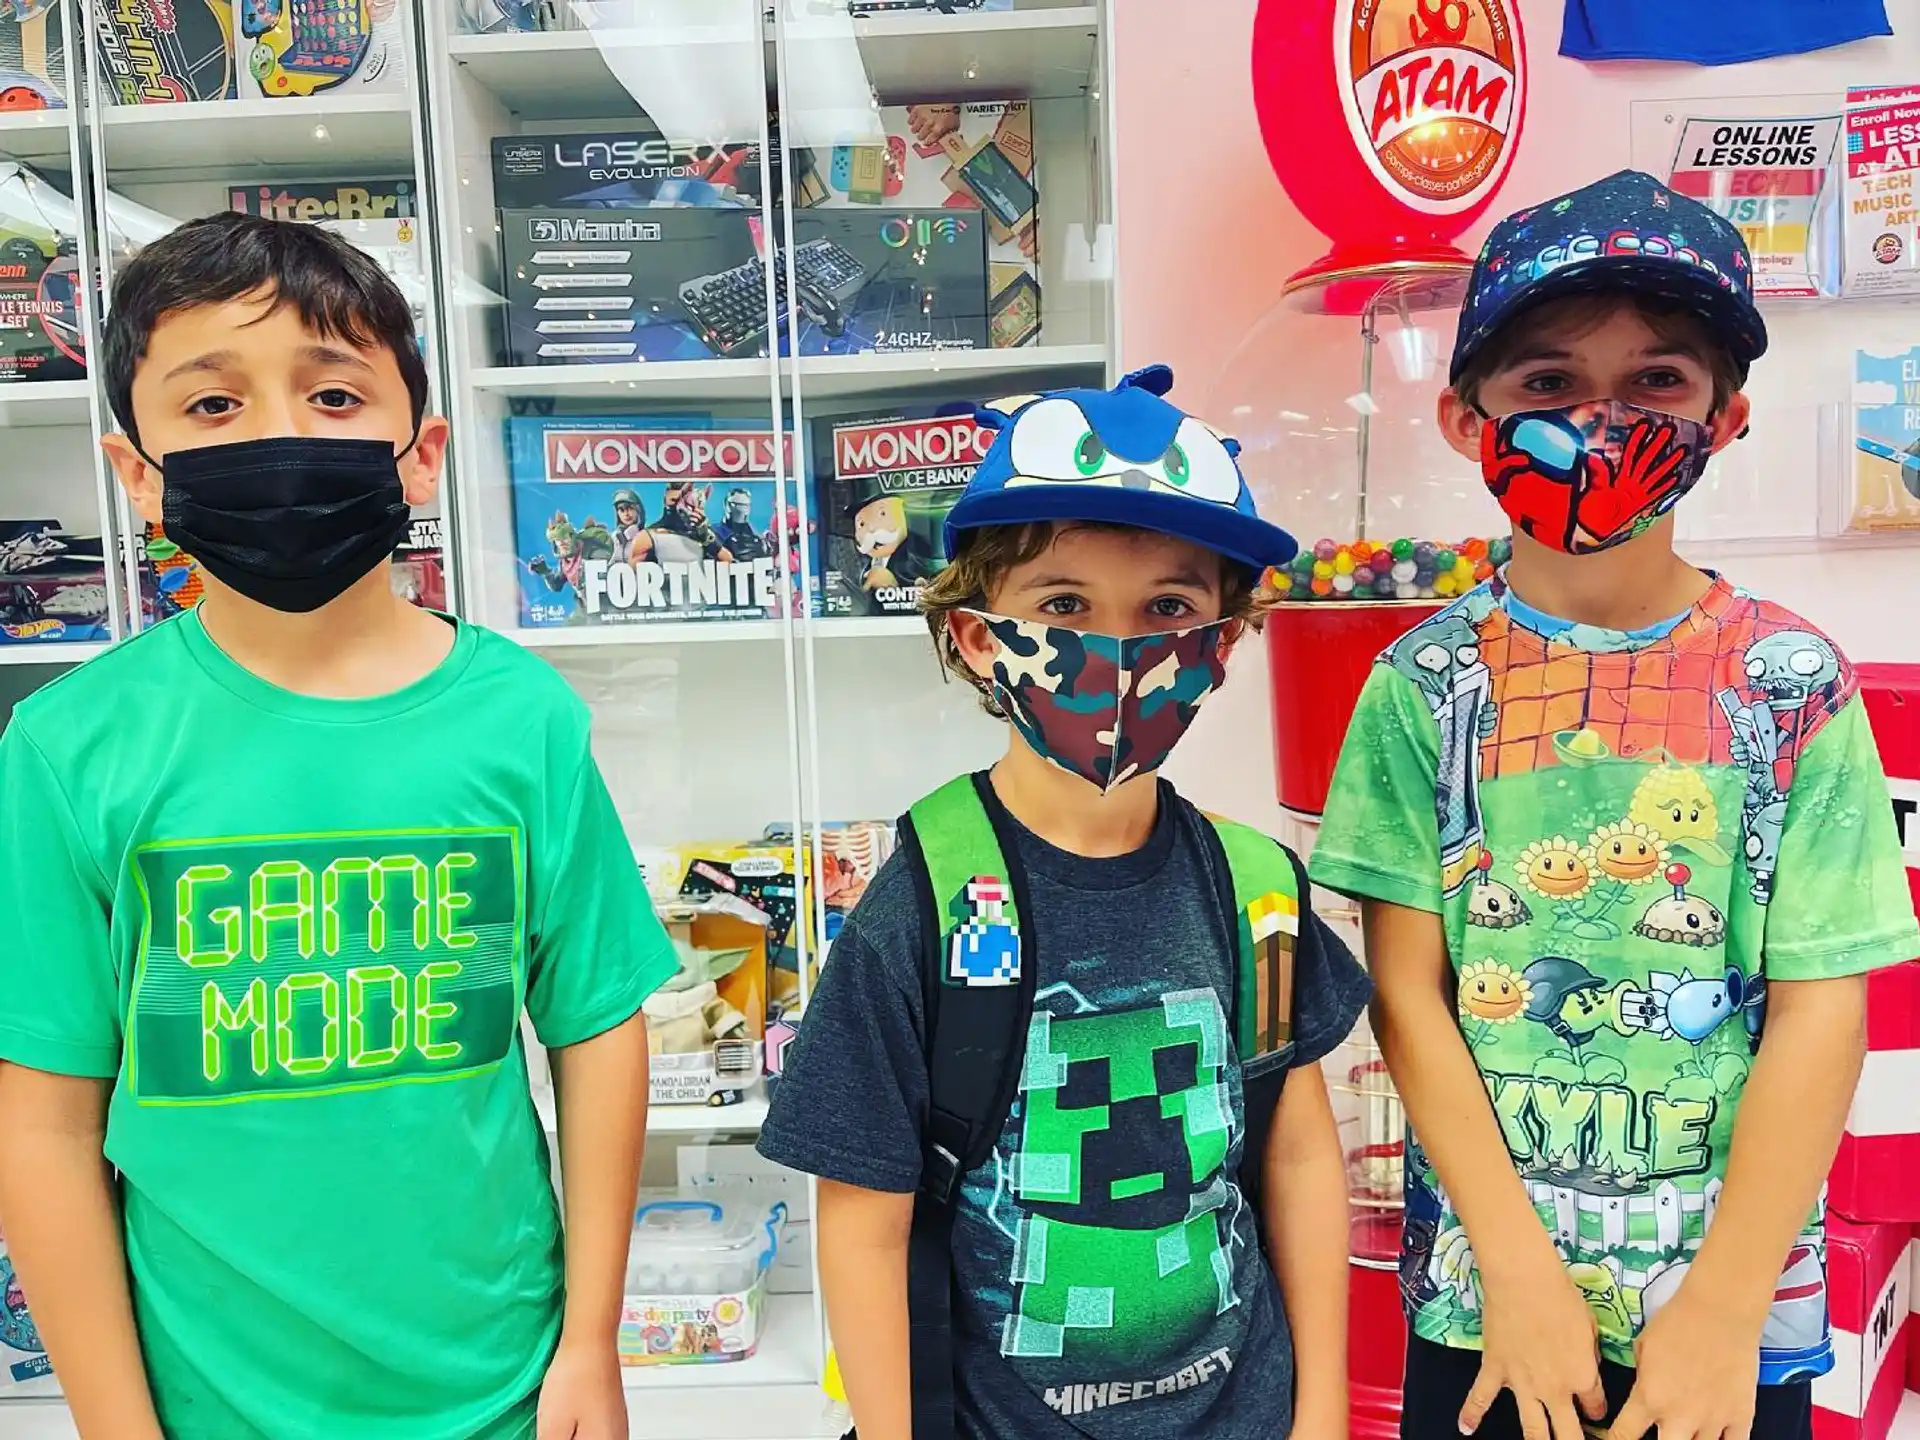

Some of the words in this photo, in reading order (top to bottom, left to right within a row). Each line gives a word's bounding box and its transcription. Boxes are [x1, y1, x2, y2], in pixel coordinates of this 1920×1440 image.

[966, 103, 1009, 114] VARIETY
[1371, 56, 1507, 142] ATAM
[1850, 110, 1890, 127] Enroll
[1712, 125, 1816, 146] ONLINE
[1692, 146, 1818, 167] LESSONS
[589, 165, 701, 180] EVOLUTION
[1862, 173, 1912, 194] TECH
[1854, 193, 1912, 215] MUSIC
[562, 218, 661, 241] Mamba
[19, 301, 64, 314] TENNIS
[874, 330, 933, 347] 2.4GHZ
[842, 424, 997, 470] MONOPO
[881, 470, 926, 489] VOICE
[585, 556, 776, 614] FORTNITE
[176, 851, 479, 968] GAME
[202, 960, 463, 1082] MODE
[655, 1089, 673, 1099] THE
[1873, 1280, 1896, 1361] TNT
[1043, 1346, 1235, 1416] MINECRAFT
